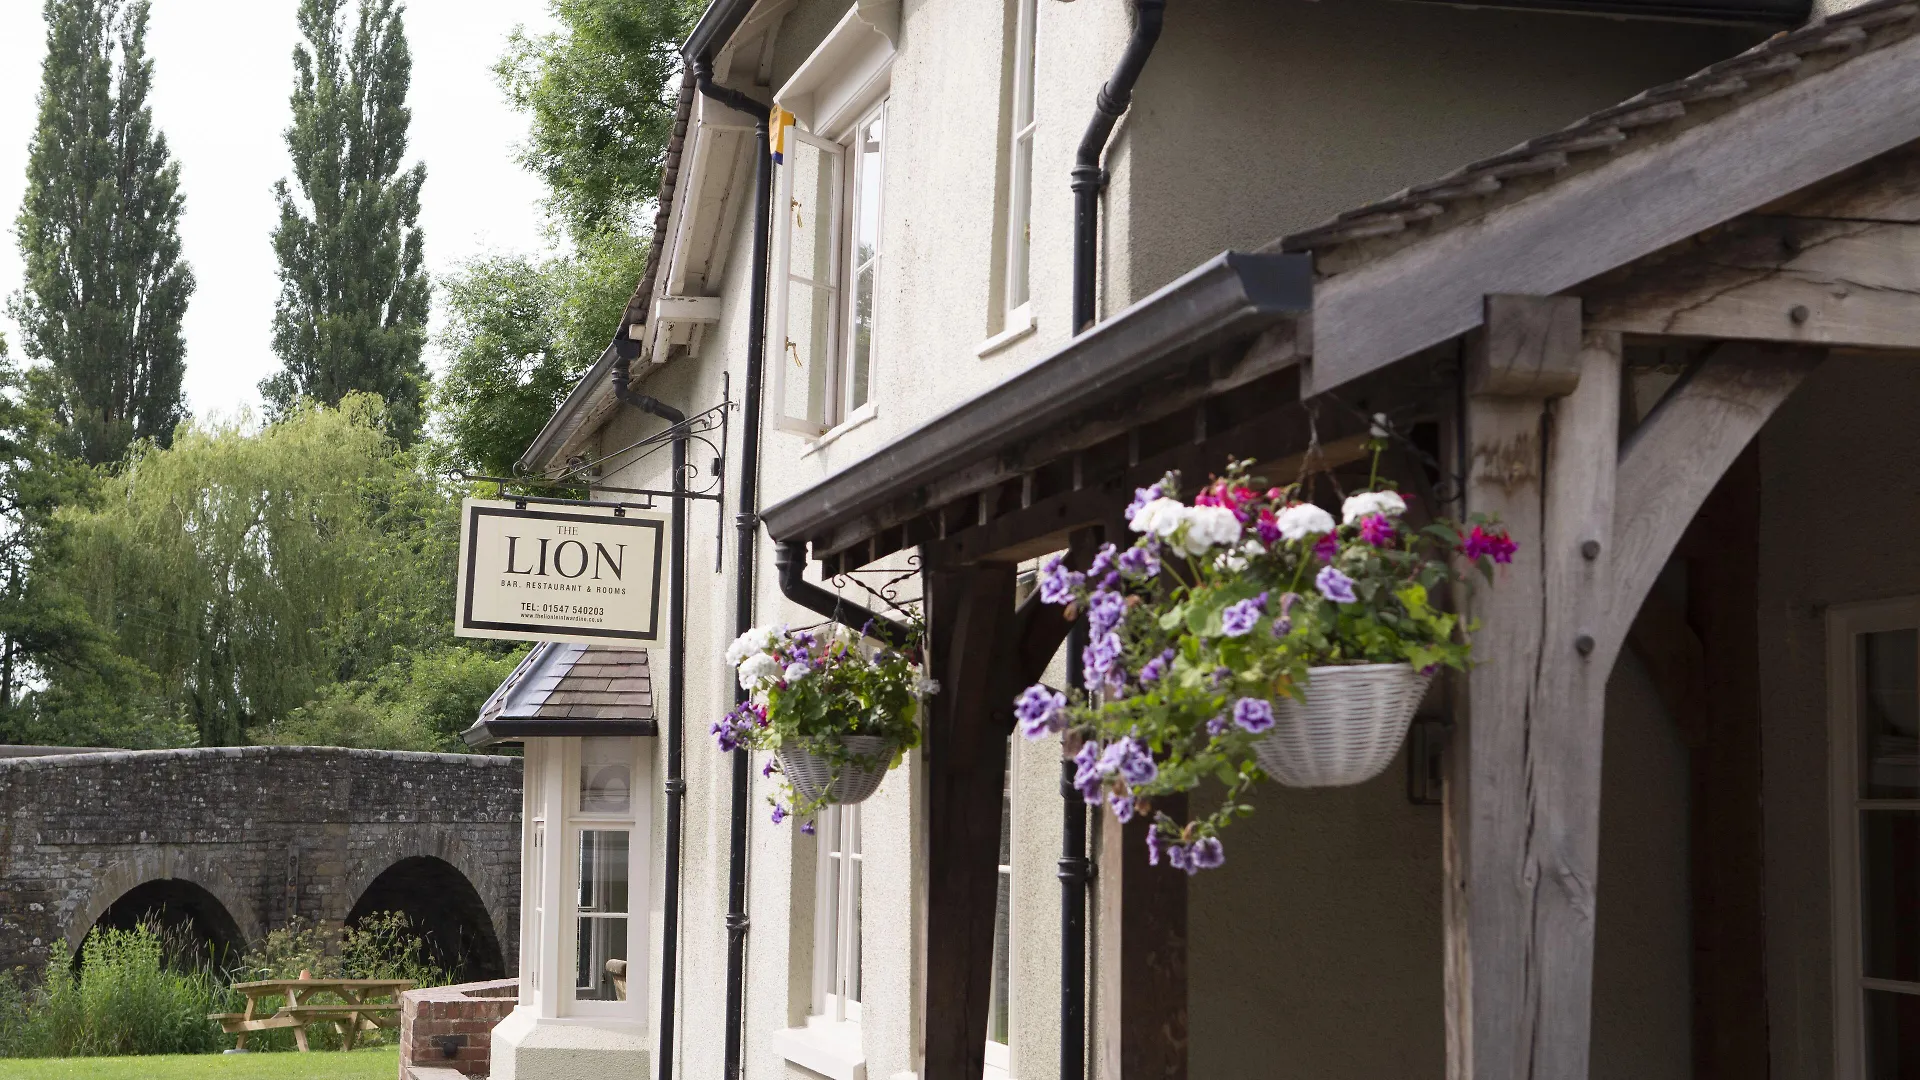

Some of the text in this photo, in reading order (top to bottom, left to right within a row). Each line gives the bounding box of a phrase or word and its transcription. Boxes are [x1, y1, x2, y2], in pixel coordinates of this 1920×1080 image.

[557, 525, 579, 536] THE
[502, 535, 628, 581] LION
[526, 581, 582, 593] RESTAURANT
[586, 585, 592, 593] &
[596, 586, 626, 595] ROOMS
[520, 602, 604, 616] TEL: 01547 540203
